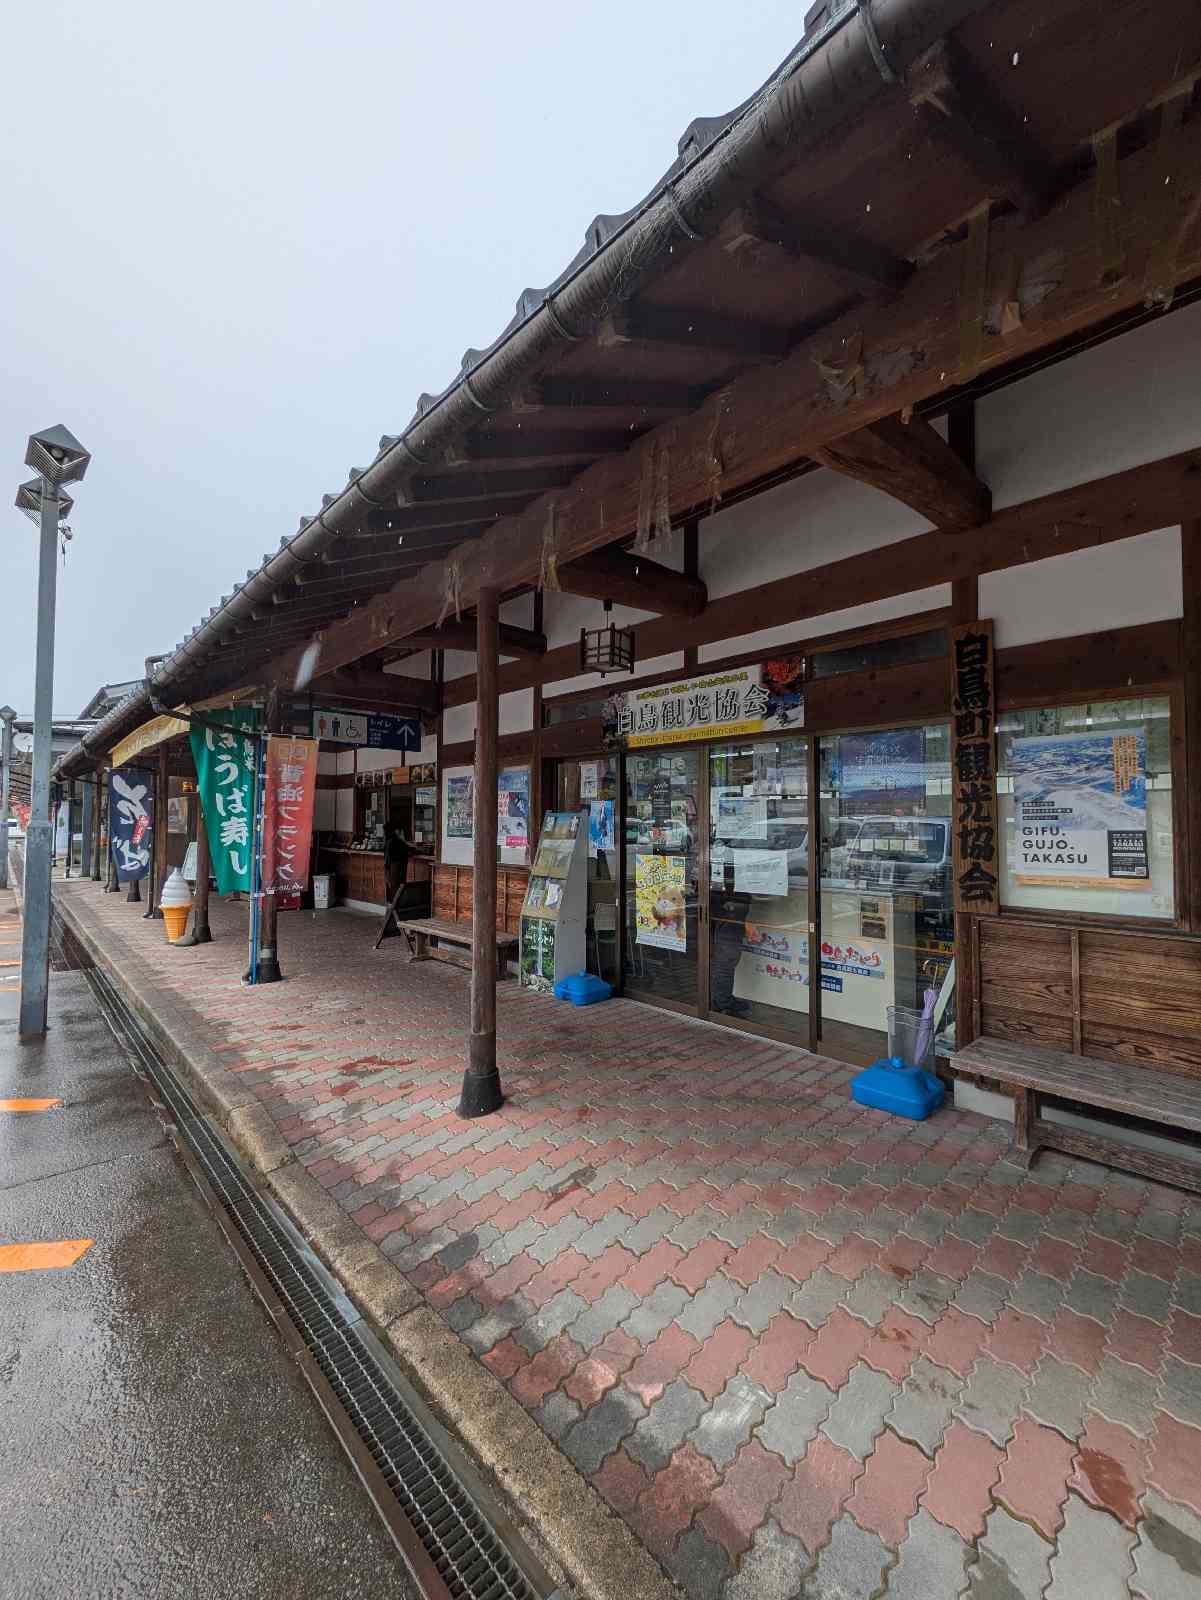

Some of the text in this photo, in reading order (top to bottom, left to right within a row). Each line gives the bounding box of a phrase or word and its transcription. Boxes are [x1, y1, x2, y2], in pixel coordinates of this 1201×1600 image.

[617, 683, 770, 735] 白鳥観光協会
[955, 632, 997, 902] 白鳥町観光協会
[1022, 826, 1066, 836] GIFU.
[1022, 839, 1075, 850] GUJO.
[1022, 853, 1088, 864] TAKASU
